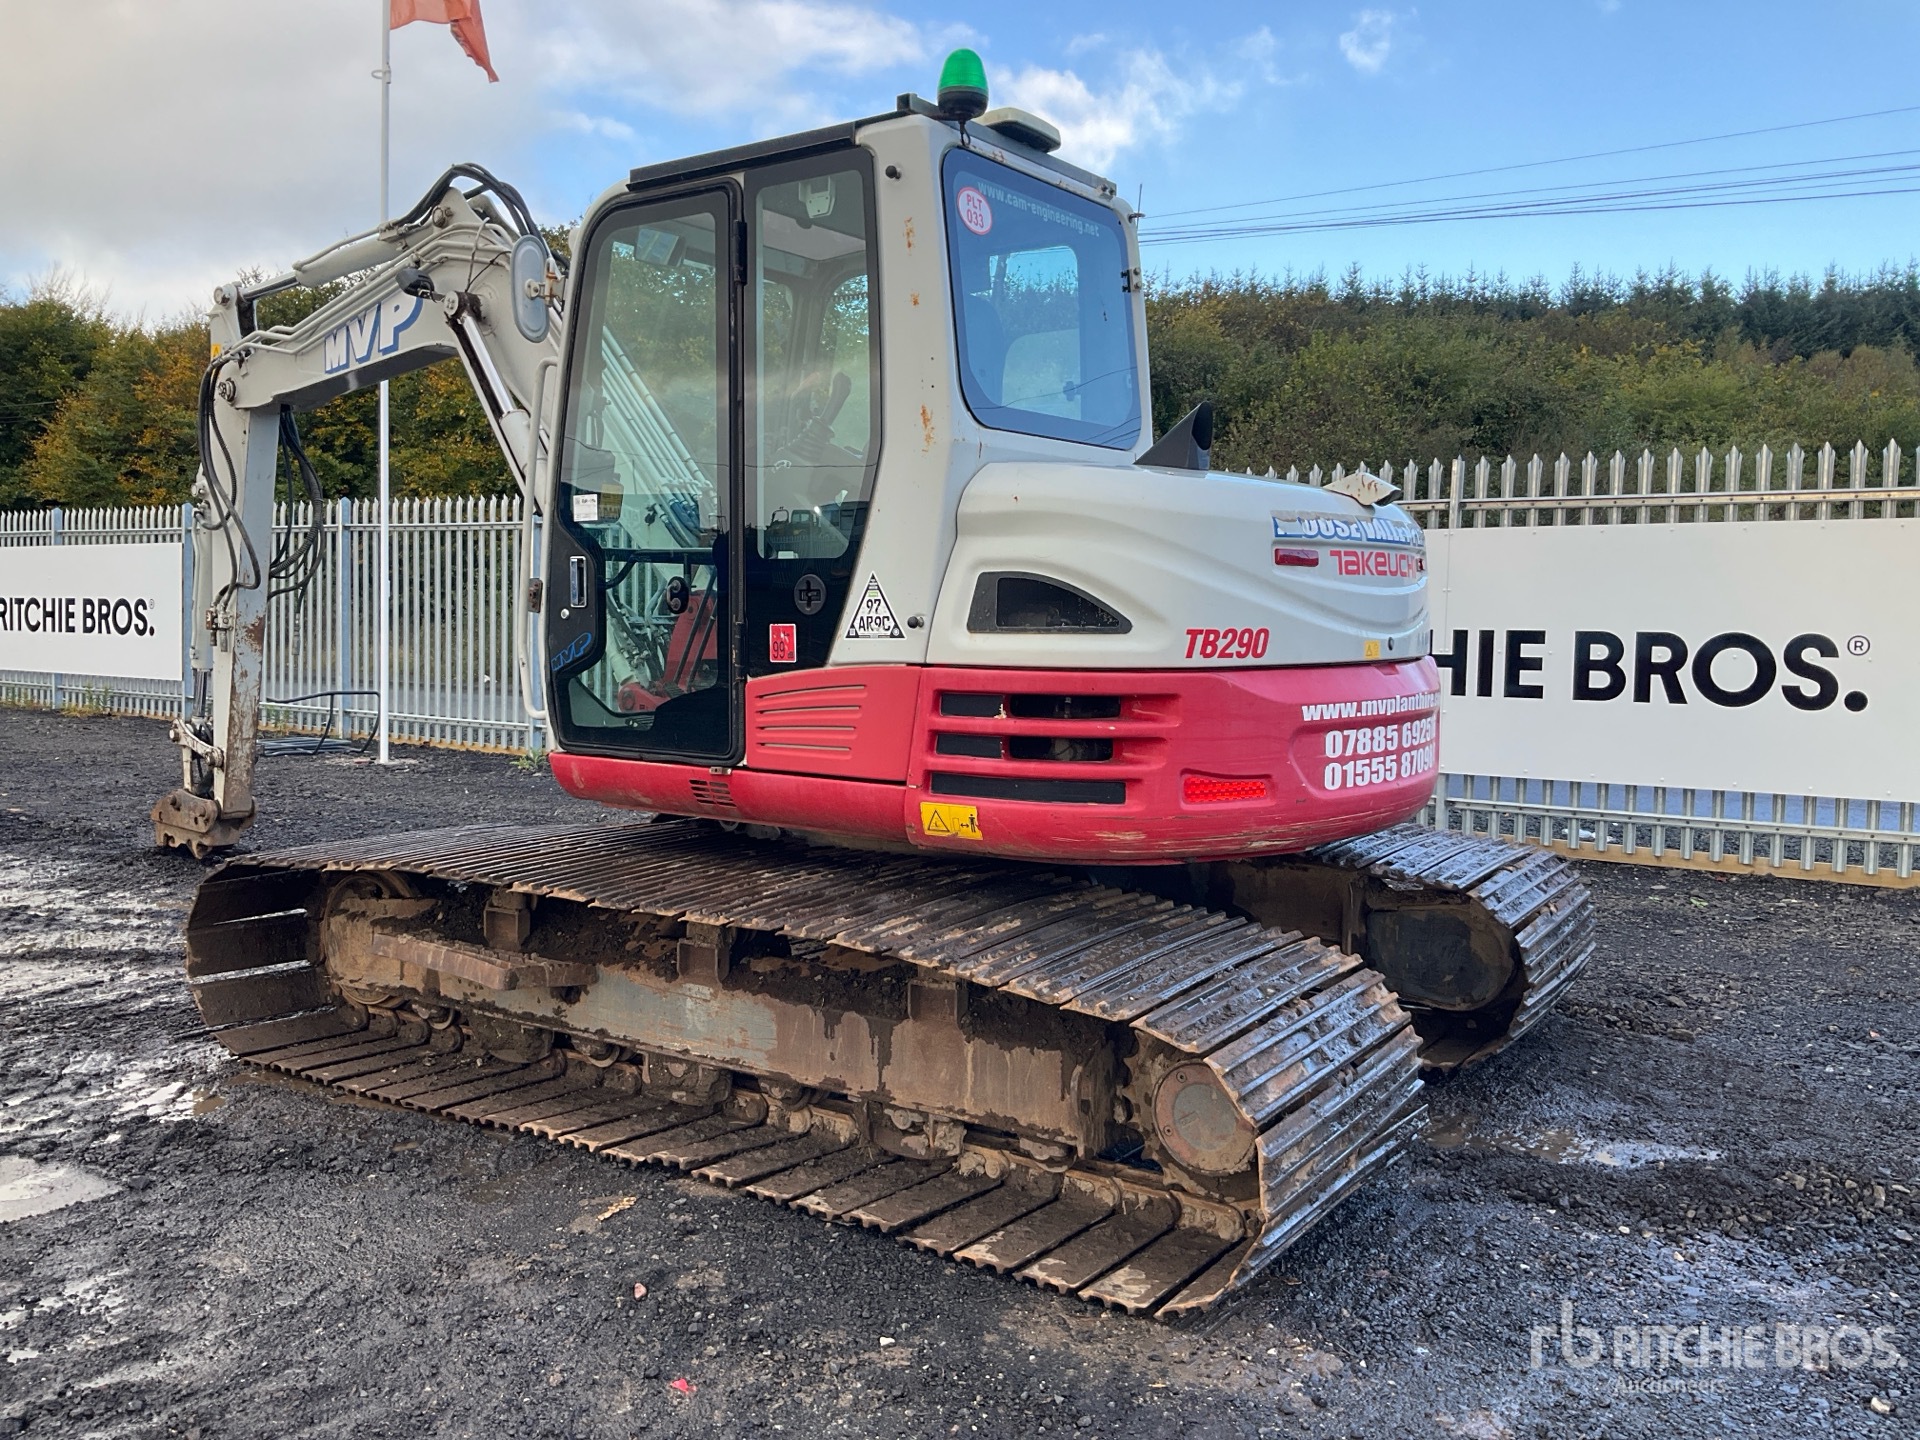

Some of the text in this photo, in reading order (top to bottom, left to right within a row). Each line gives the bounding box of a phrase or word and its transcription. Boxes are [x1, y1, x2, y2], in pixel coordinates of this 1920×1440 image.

[966, 193, 983, 211] PLT
[966, 210, 985, 229] 033
[977, 181, 1100, 238] www.cam-engineering.net
[324, 296, 424, 375] MVP
[866, 598, 882, 615] 97
[550, 631, 593, 672] MVP
[1185, 627, 1270, 660] TB290
[1325, 724, 1399, 759] 07885
[1324, 754, 1398, 791] 01555
